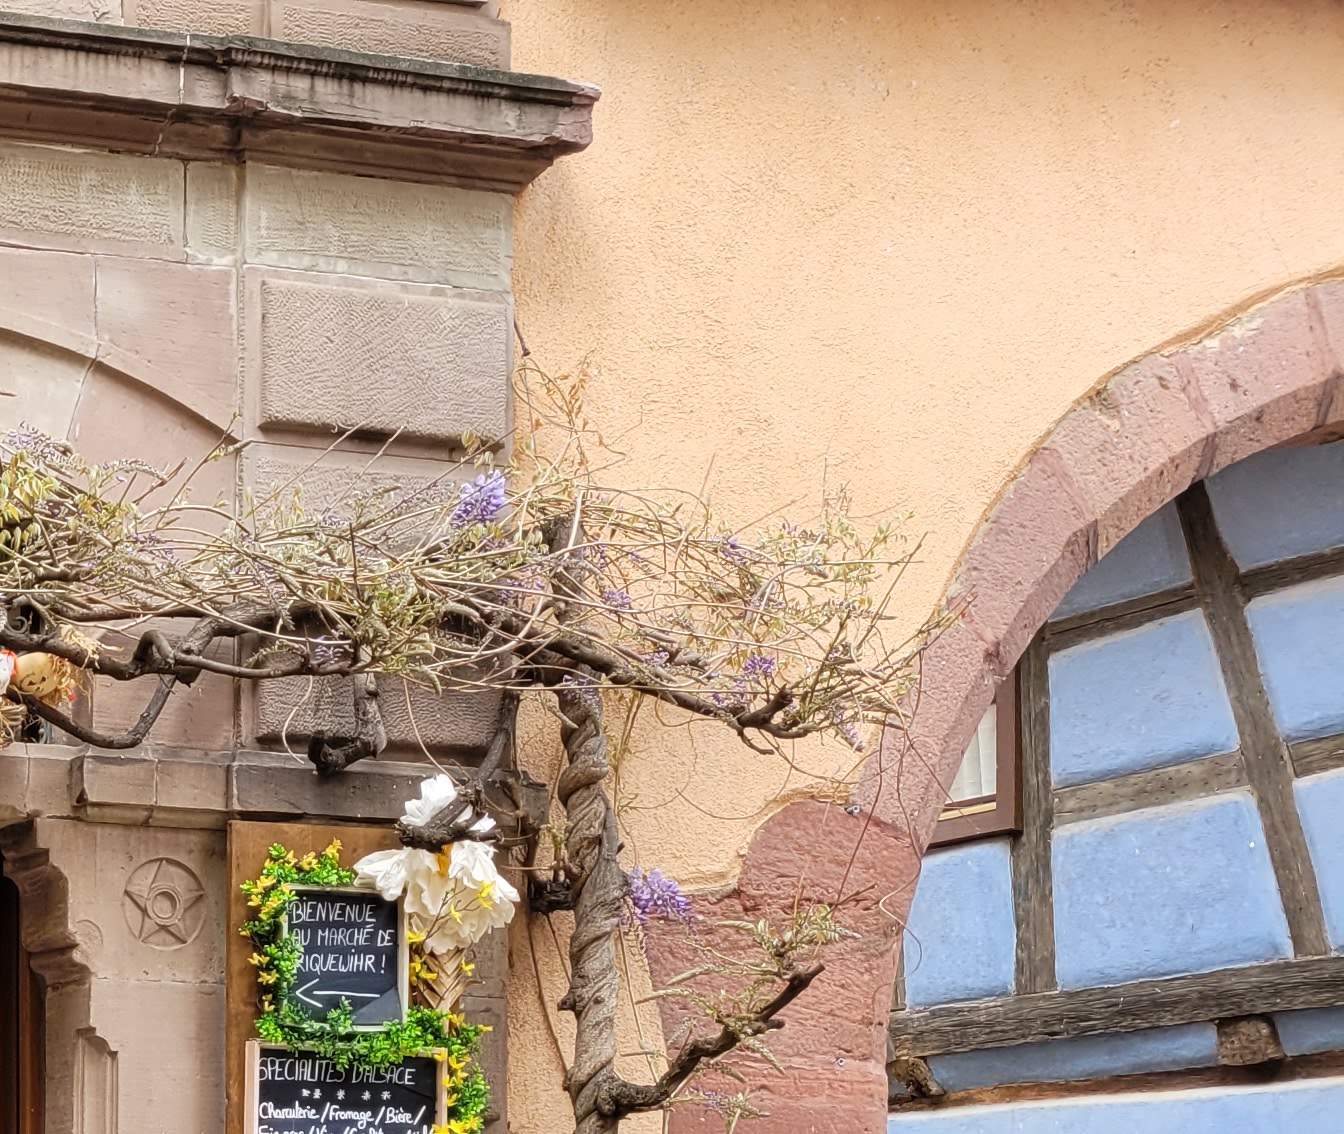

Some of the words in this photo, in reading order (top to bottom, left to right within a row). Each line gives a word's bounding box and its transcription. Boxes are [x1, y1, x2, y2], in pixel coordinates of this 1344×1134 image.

[292, 927, 311, 947] AU
[317, 923, 375, 947] MARCHÉ
[377, 929, 396, 947] DE
